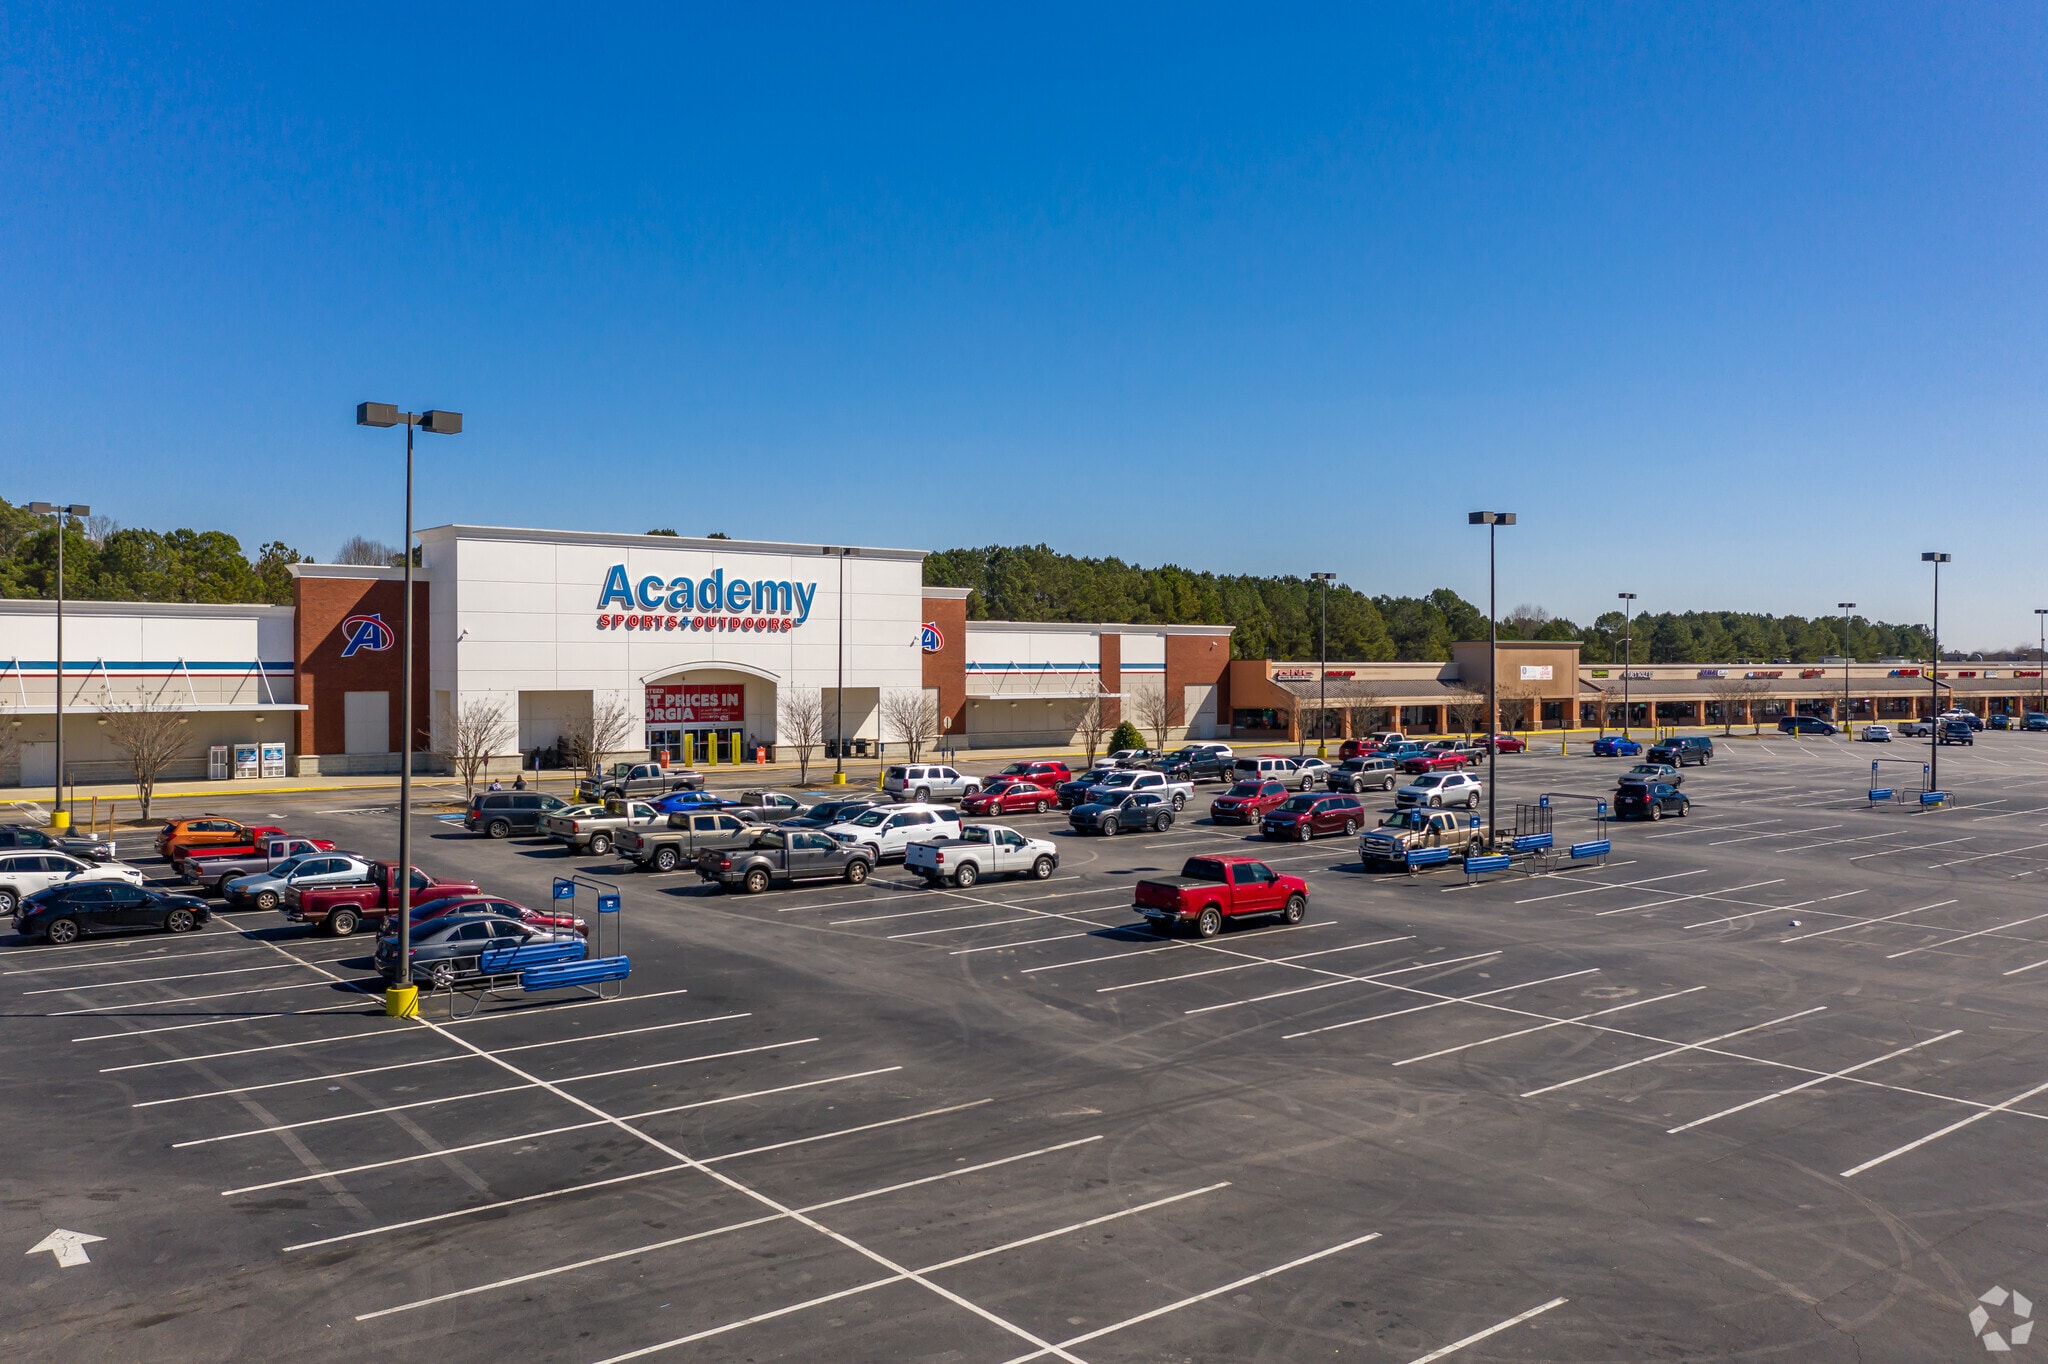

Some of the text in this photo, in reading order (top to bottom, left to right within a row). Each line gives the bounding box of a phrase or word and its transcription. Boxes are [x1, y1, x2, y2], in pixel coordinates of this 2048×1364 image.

[599, 563, 818, 625] Academy
[341, 613, 383, 658] A
[600, 613, 678, 628] SPORTS
[693, 616, 792, 630] OUTDOORS
[665, 693, 719, 708] PRICES
[721, 693, 739, 707] IN
